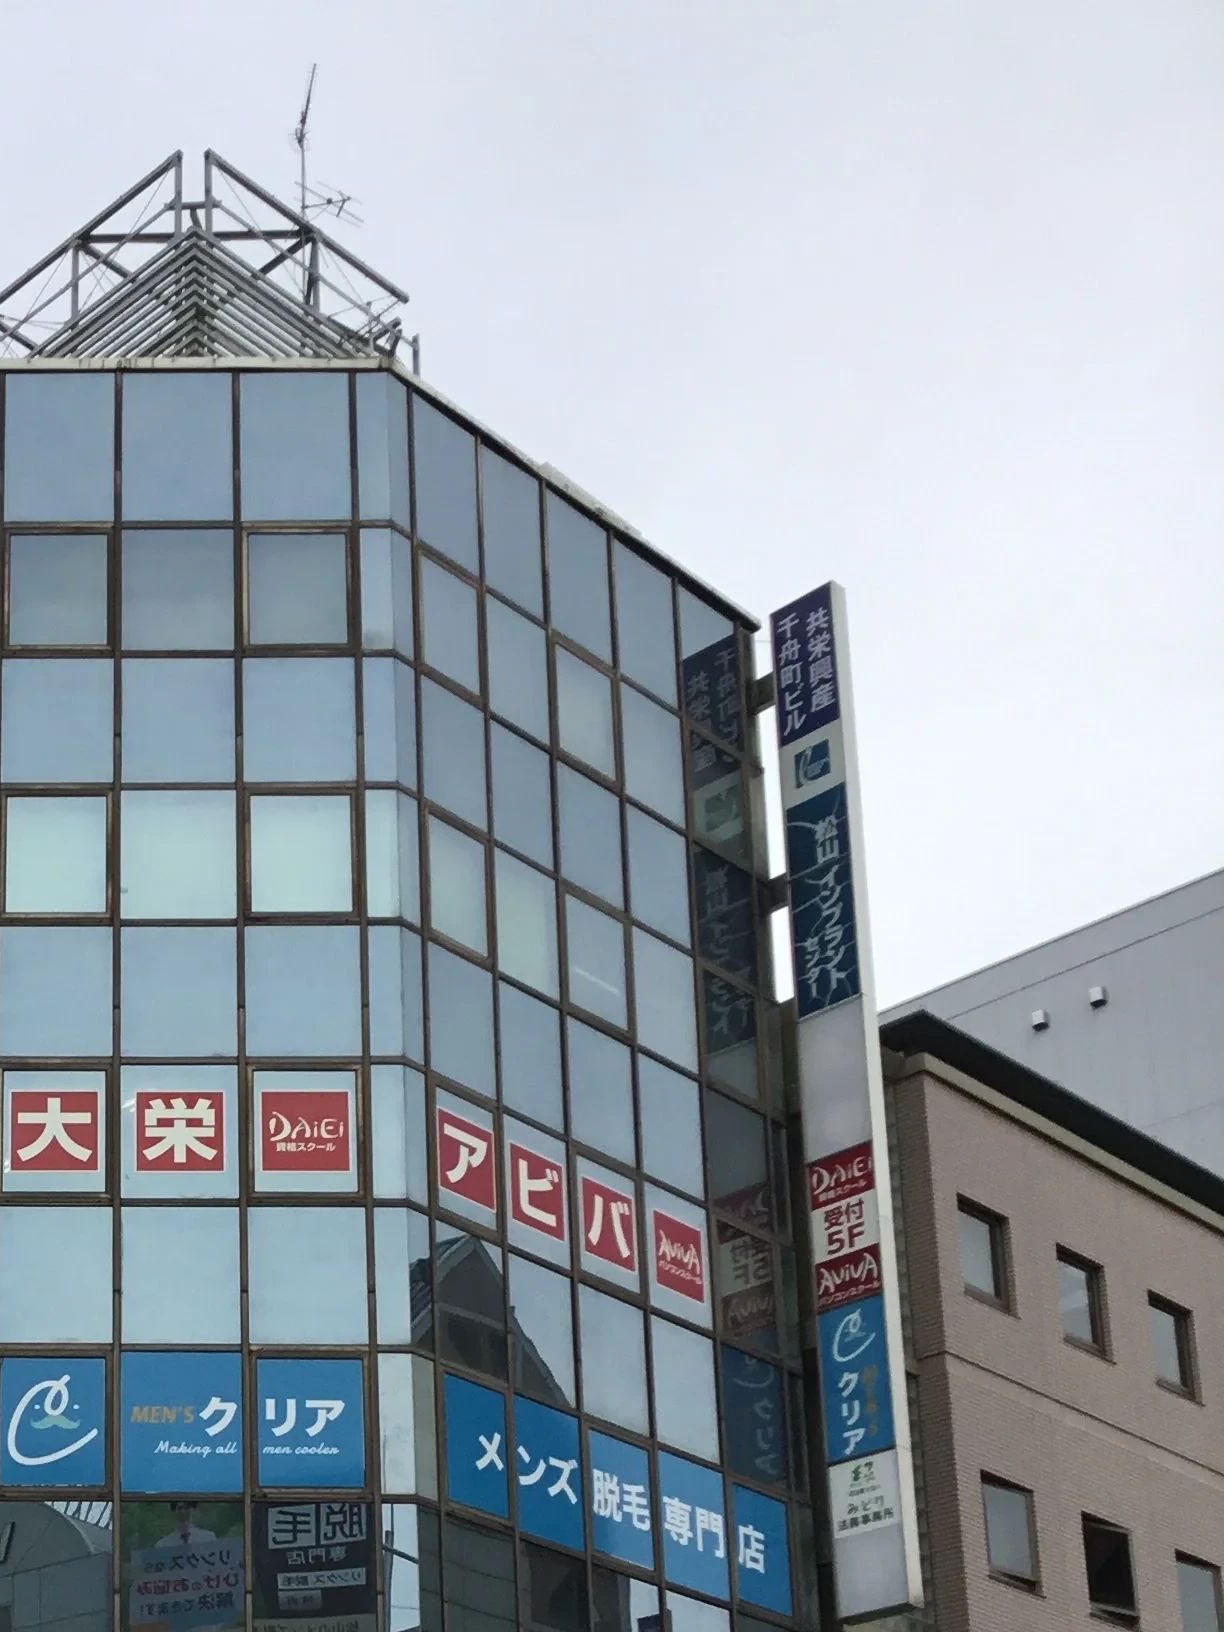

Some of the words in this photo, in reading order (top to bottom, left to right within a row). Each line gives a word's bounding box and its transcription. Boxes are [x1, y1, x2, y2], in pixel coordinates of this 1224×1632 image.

[777, 612, 806, 736] 千舟町ビル
[806, 606, 835, 713] 共栄興産
[16, 1097, 218, 1163] 大栄
[276, 1142, 336, 1153] 資格スクール
[443, 1122, 631, 1259] アビバ
[824, 1199, 864, 1231] 受付
[827, 1224, 865, 1255] 5F
[131, 1404, 195, 1424] MEN'S
[199, 1396, 346, 1437] クリア
[839, 1372, 868, 1457] クリア
[154, 1439, 212, 1457] Making
[215, 1442, 238, 1454] all
[263, 1445, 291, 1454] men
[476, 1431, 766, 1574] メンズ脱毛専門店
